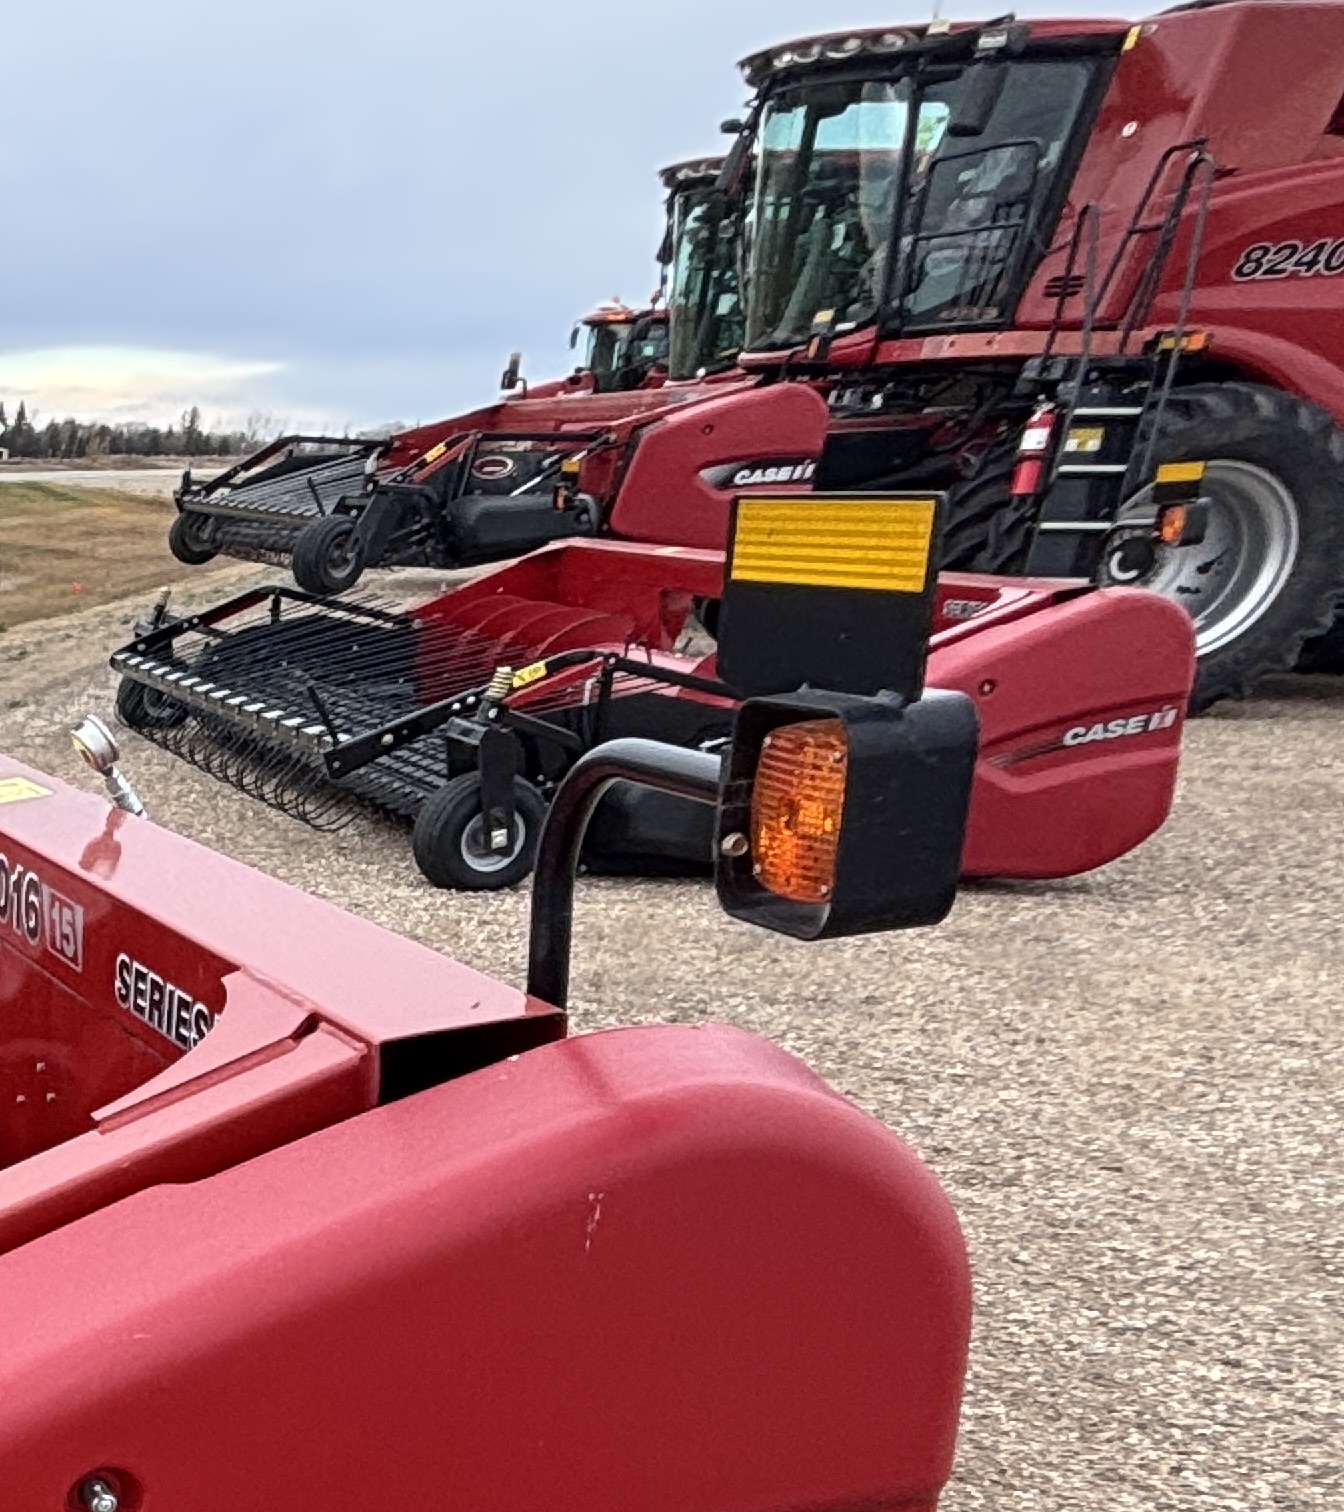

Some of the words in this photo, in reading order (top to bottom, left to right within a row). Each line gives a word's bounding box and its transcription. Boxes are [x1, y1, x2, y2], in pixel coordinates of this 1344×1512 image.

[1232, 238, 1344, 281] 8240
[734, 466, 793, 485] CASE
[1063, 714, 1149, 746] CASE
[52, 900, 76, 958] 15
[115, 952, 211, 1050] SERIES
